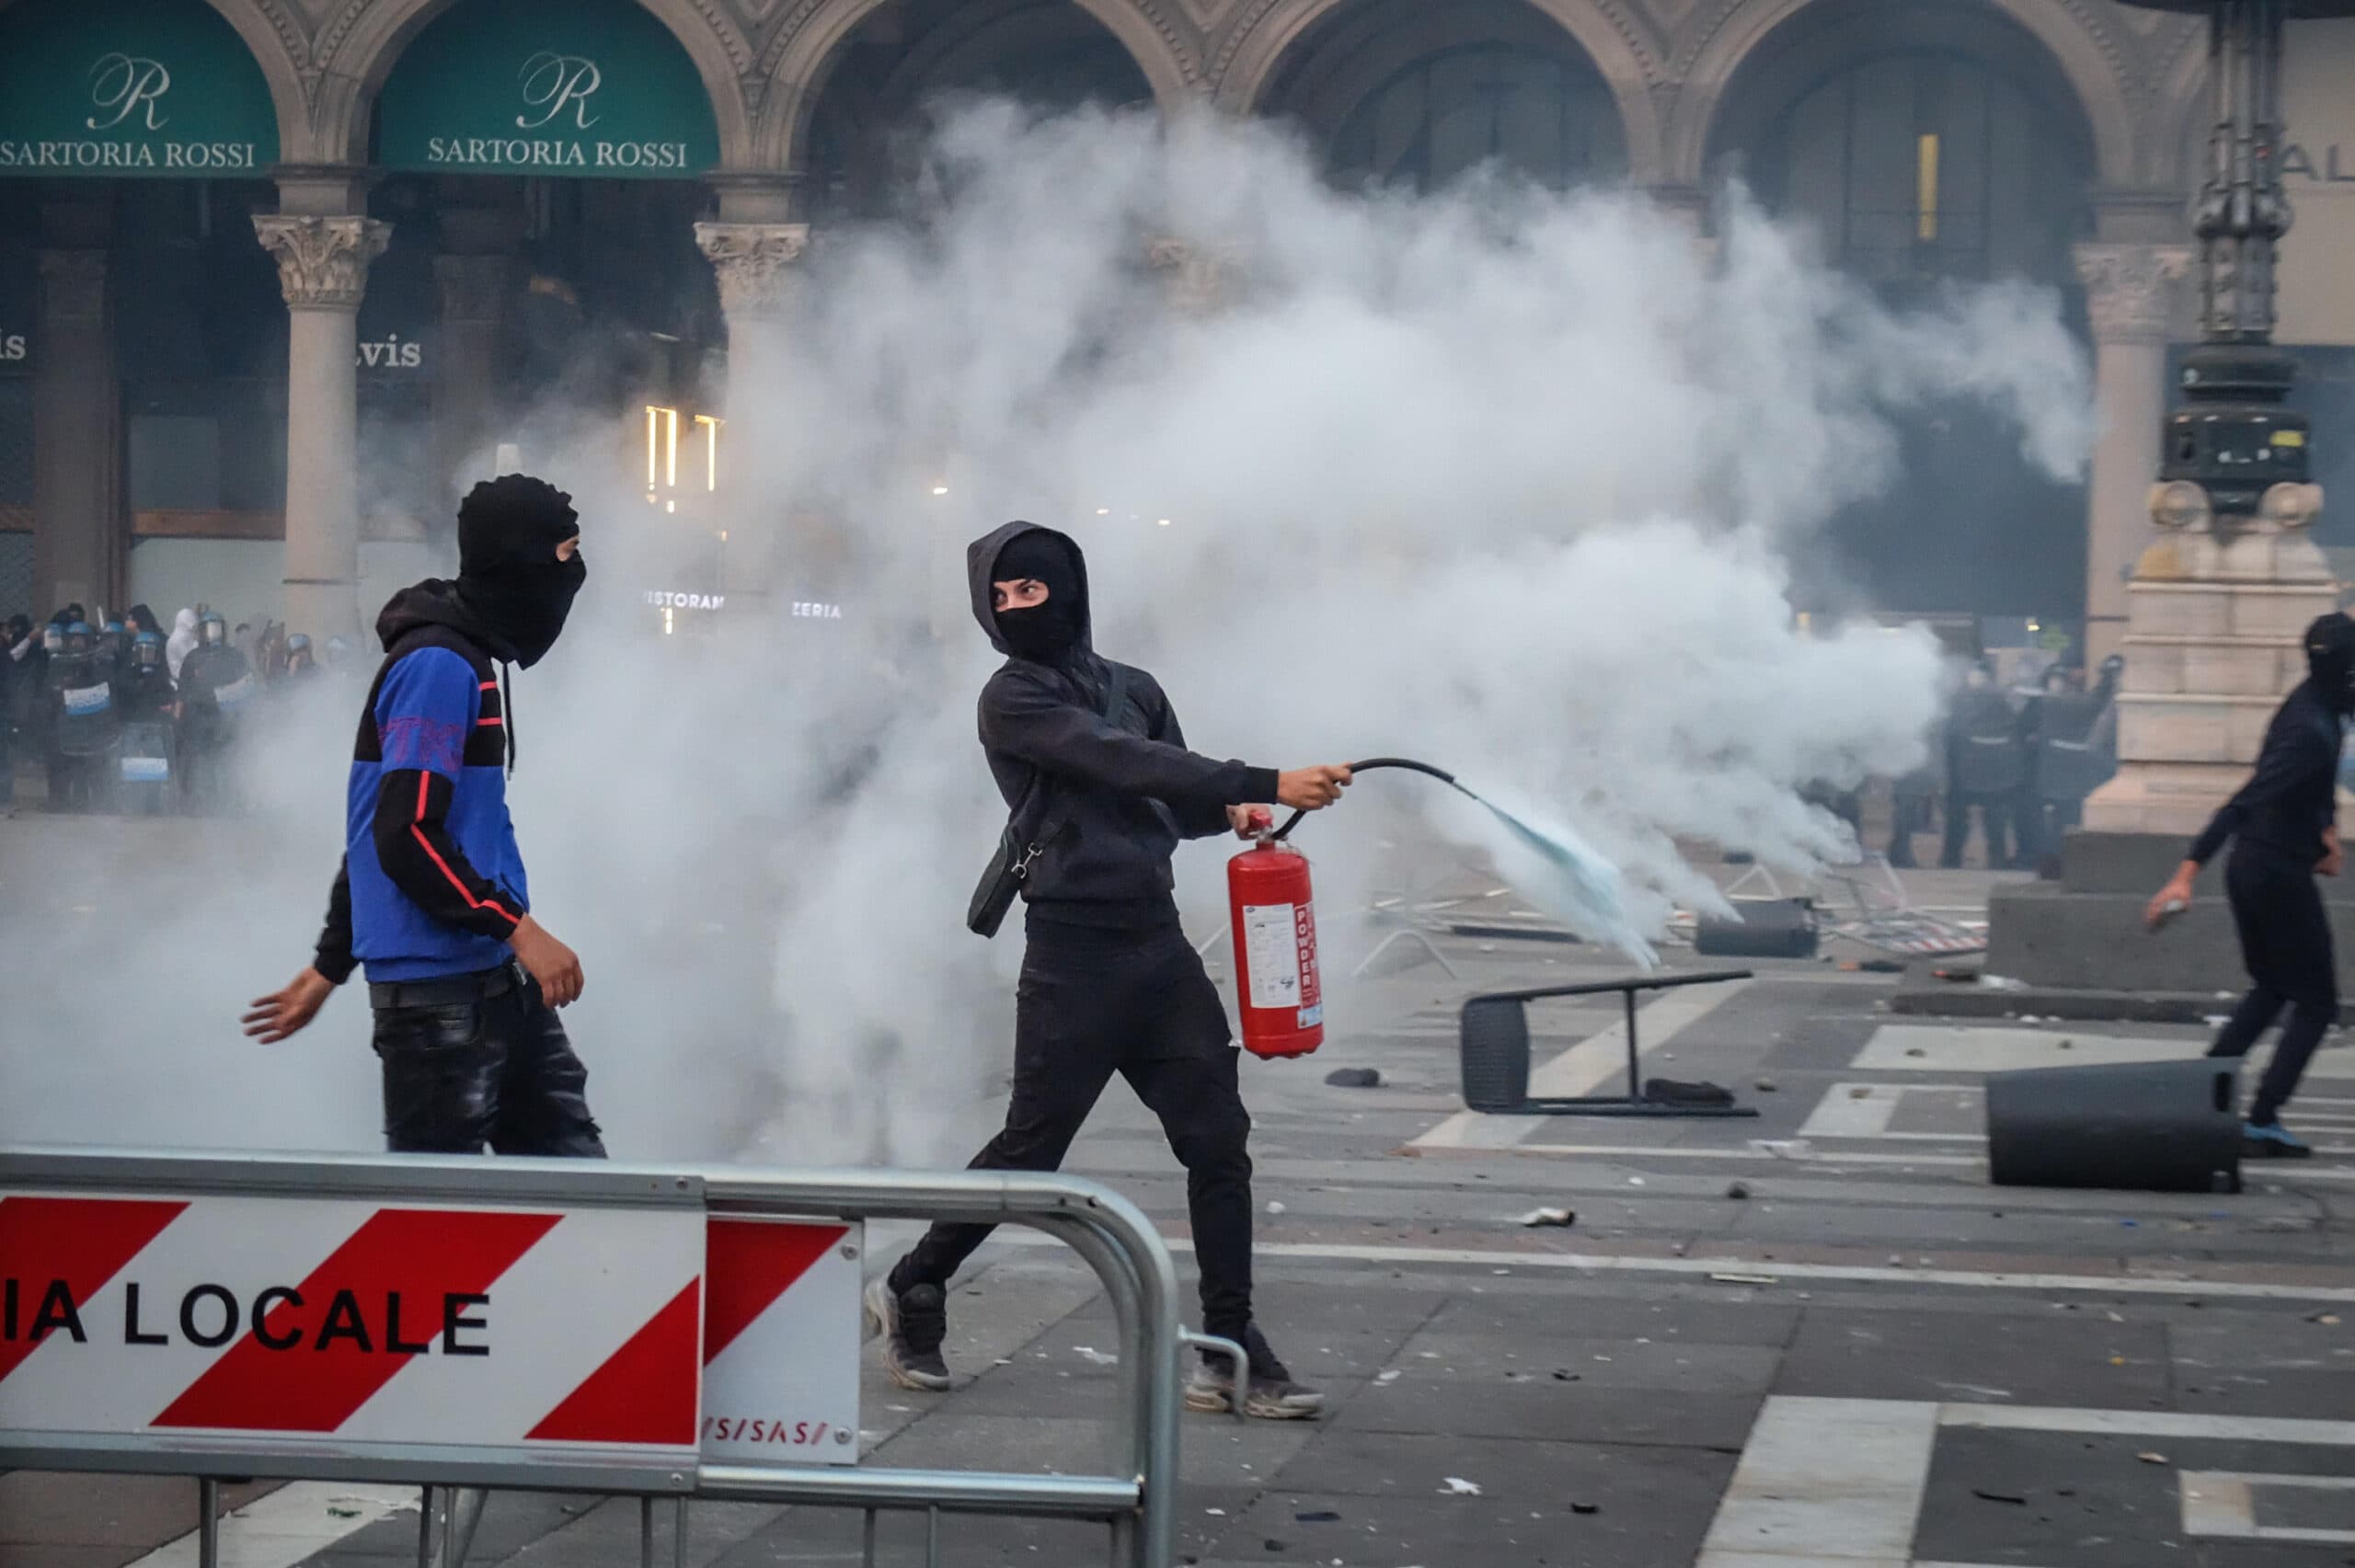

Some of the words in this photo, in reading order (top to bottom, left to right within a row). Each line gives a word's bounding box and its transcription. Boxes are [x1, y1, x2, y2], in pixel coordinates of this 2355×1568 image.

[87, 52, 169, 130] R
[516, 52, 601, 129] R
[0, 141, 155, 166] SARTORIA
[165, 143, 255, 167] ROSSI
[428, 137, 586, 166] SARTORIA
[596, 142, 687, 167] ROSSI
[0, 328, 26, 360] s
[356, 333, 421, 367] vis
[1296, 910, 1312, 987] POWDER
[3, 1279, 87, 1343] IA
[125, 1282, 490, 1356] LOCALE
